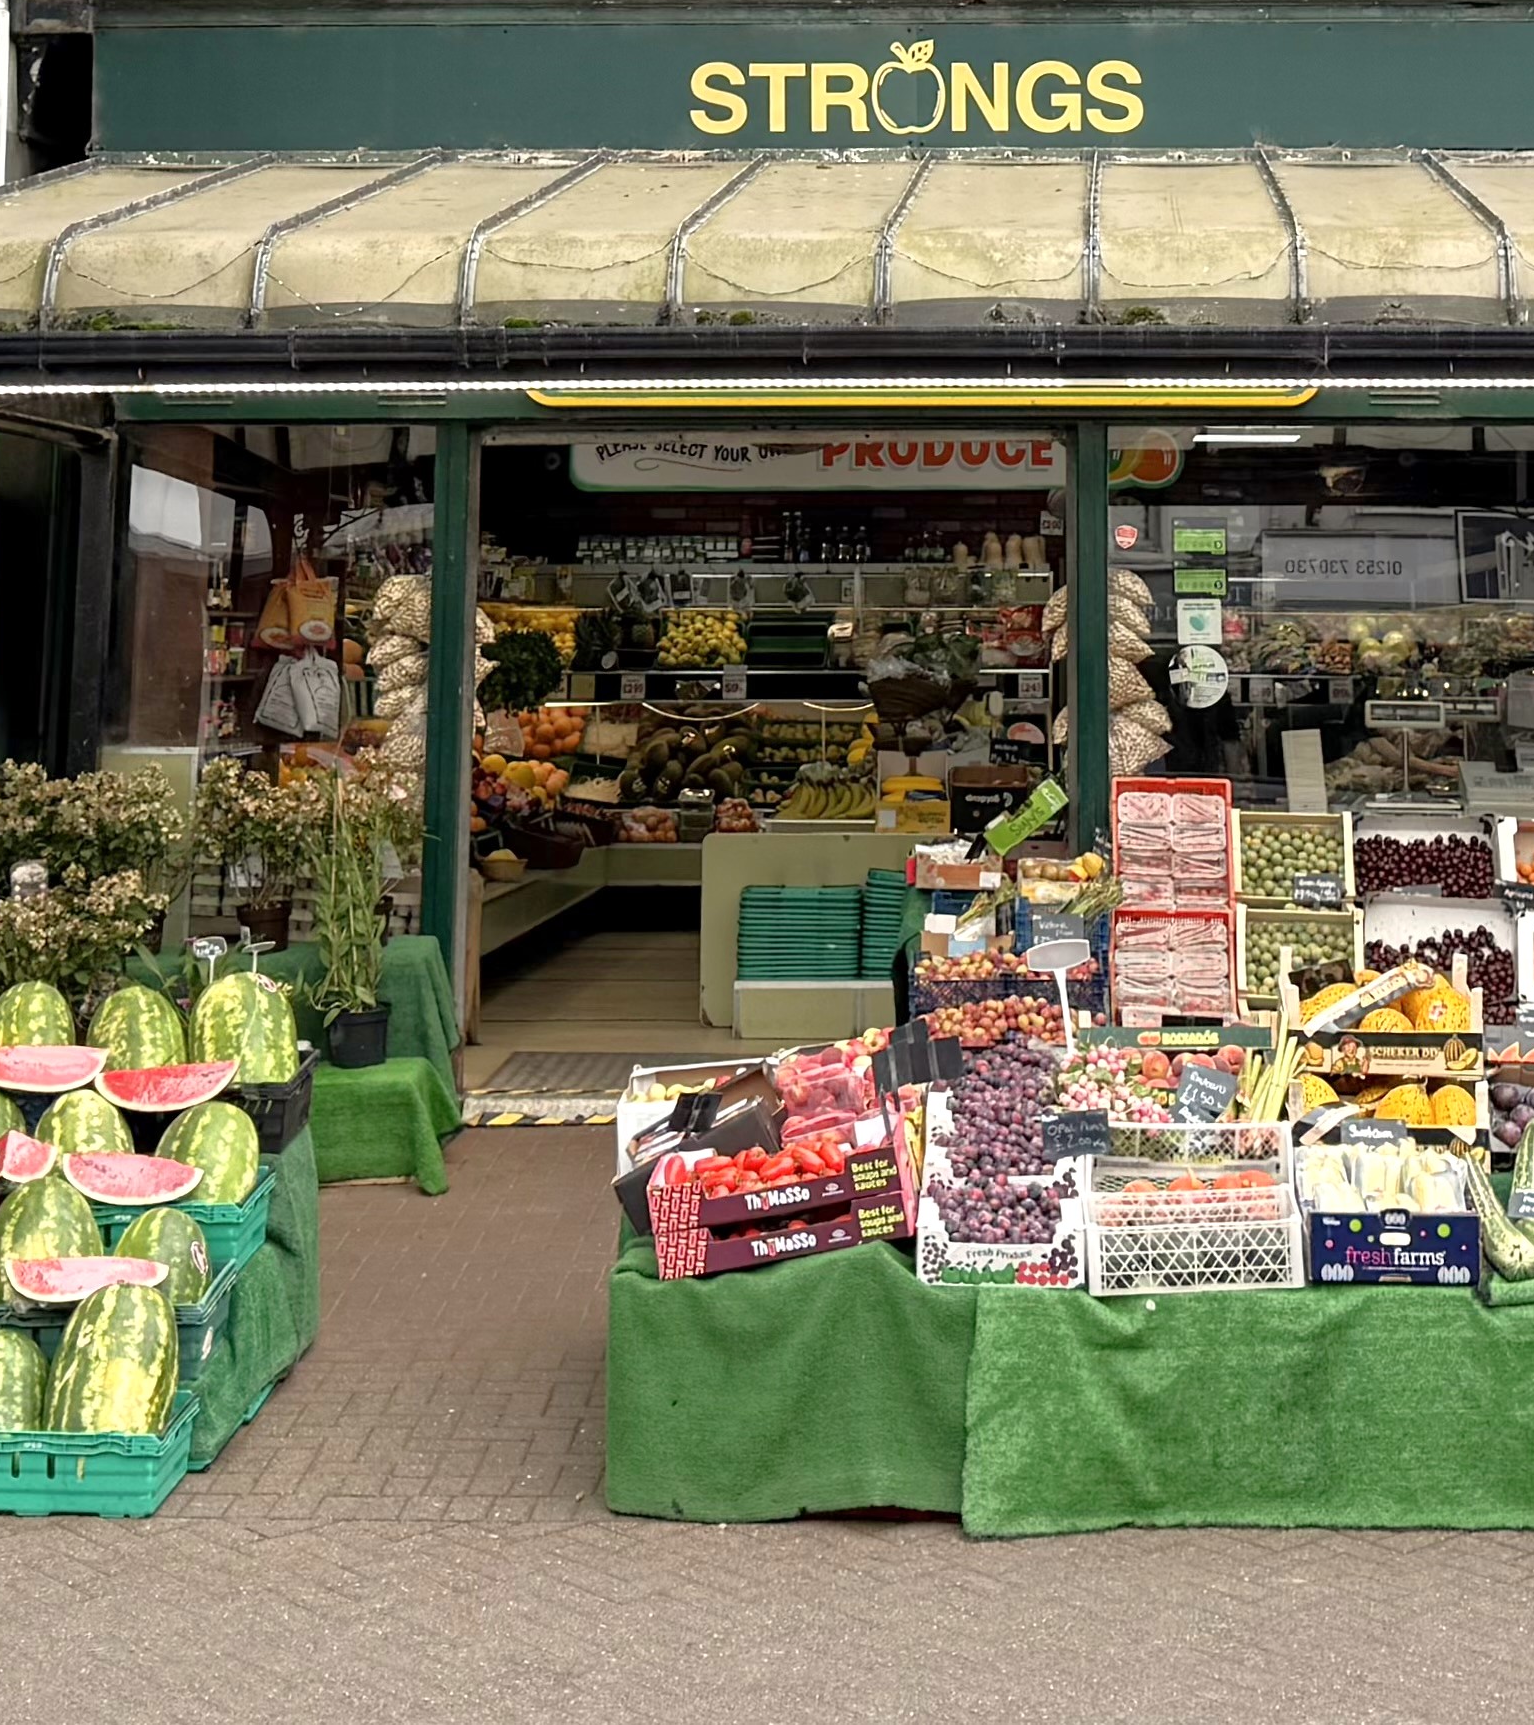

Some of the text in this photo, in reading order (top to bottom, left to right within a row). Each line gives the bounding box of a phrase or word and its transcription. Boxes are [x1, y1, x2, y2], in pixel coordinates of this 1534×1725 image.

[689, 40, 1145, 135] STRONGS
[713, 444, 752, 462] YOUR
[821, 441, 1054, 467] PRODUCE
[851, 1158, 889, 1174] Best for
[880, 1164, 898, 1176] and
[854, 1179, 888, 1192] sauces
[857, 1204, 896, 1220] Best for
[887, 1210, 905, 1223] and
[861, 1225, 895, 1238] sauces
